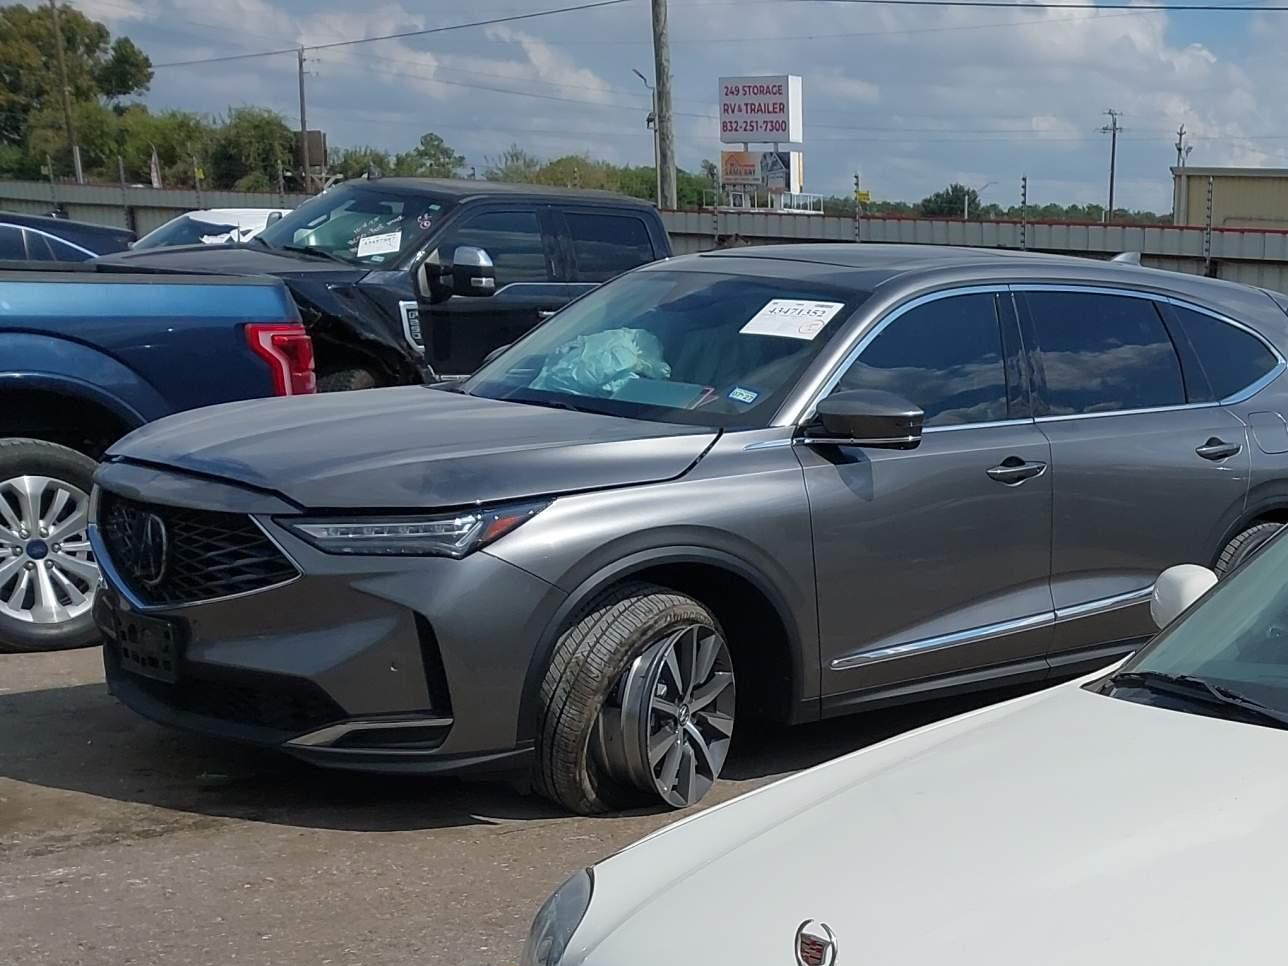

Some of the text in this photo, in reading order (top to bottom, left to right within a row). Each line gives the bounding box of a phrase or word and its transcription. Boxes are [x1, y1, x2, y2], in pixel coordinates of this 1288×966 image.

[724, 85, 783, 96] 249 STORAGE
[723, 104, 737, 115] RV
[744, 103, 785, 115] TRAILER
[722, 120, 787, 133] 832-251-7300
